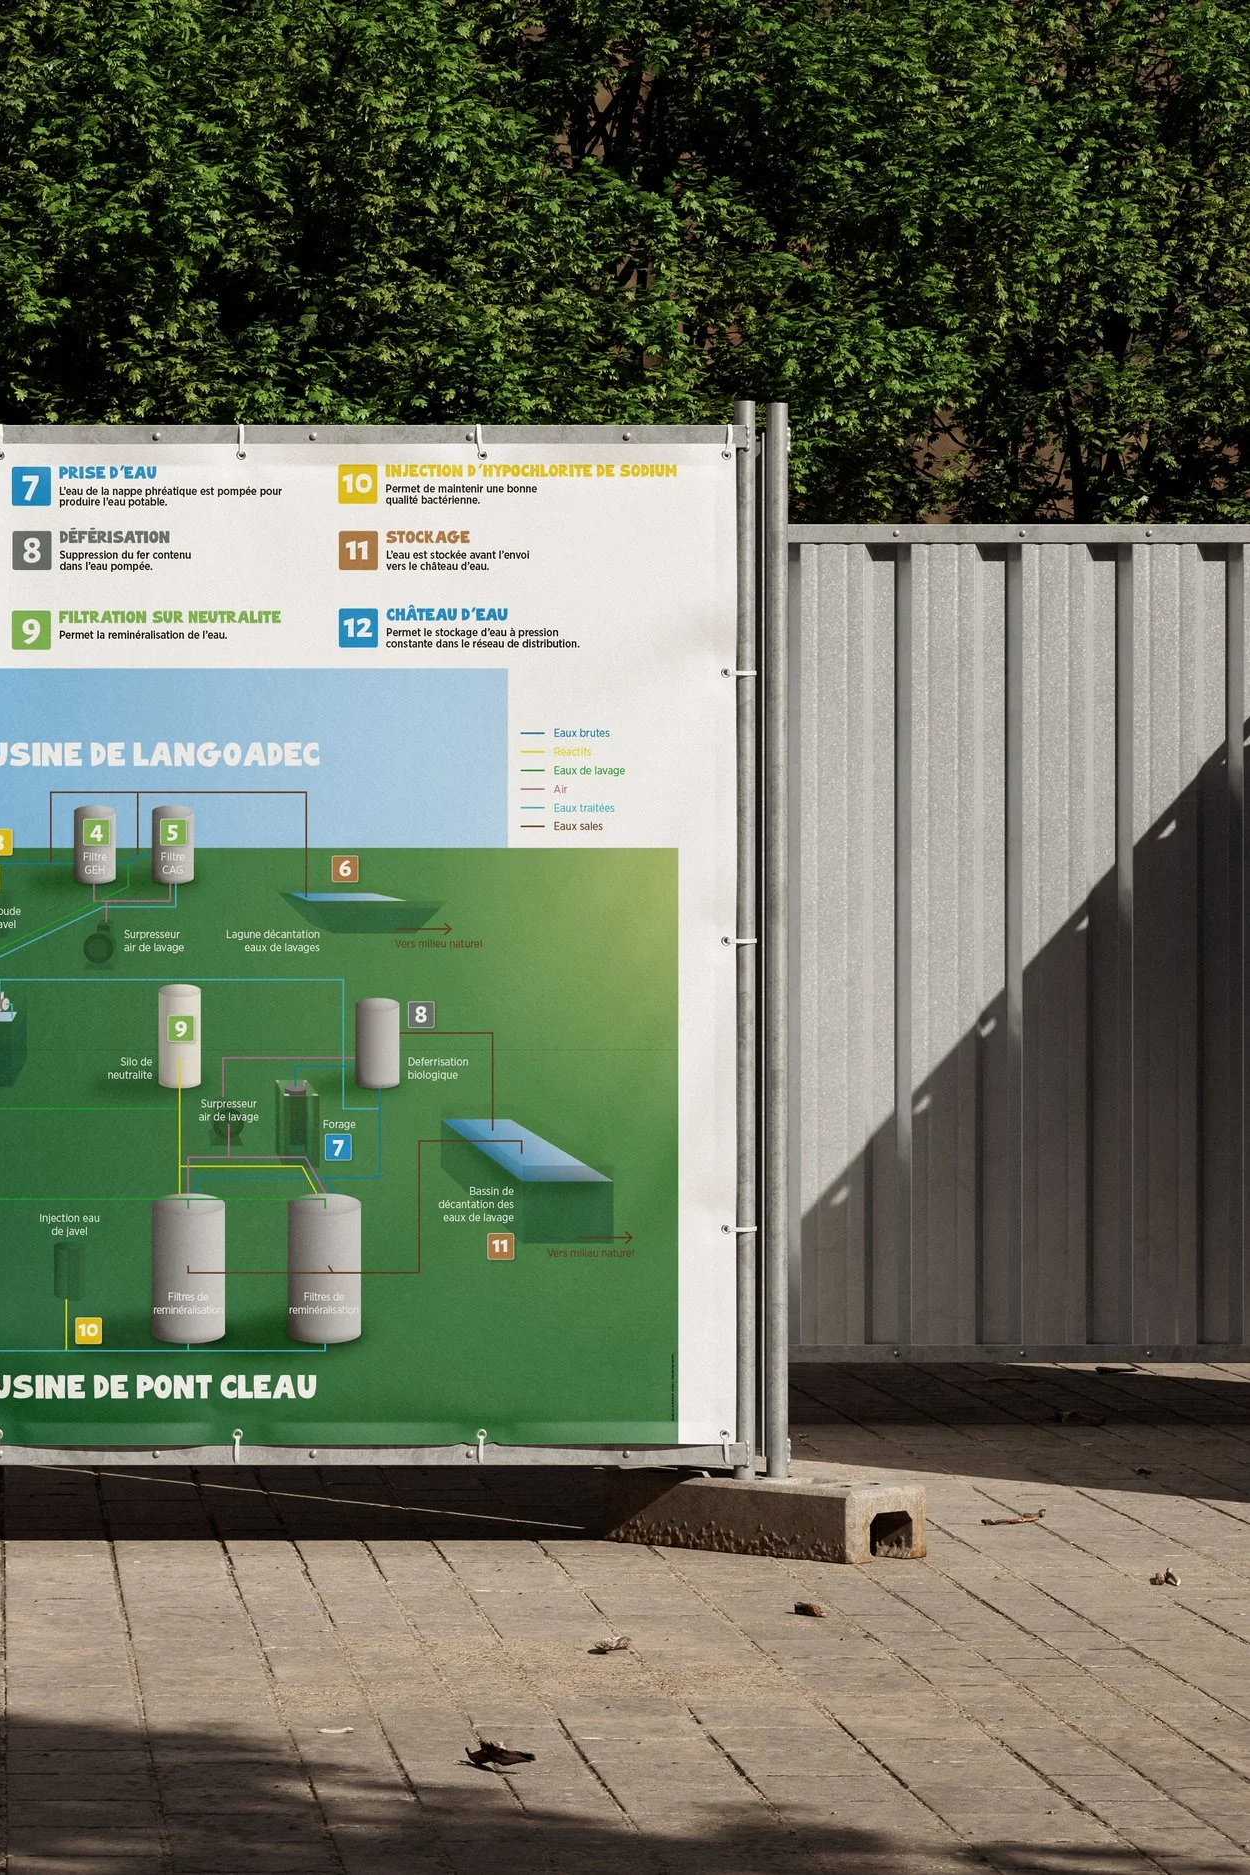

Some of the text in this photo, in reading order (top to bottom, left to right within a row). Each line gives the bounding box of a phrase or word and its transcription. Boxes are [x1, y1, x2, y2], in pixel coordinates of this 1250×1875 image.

[58, 464, 157, 480] PRISE D'EAU
[384, 462, 678, 479] INJECTION D'HYPOCHLORITE DE SODIUM
[21, 475, 40, 501] 7
[342, 474, 373, 493] 10
[59, 528, 171, 543] DÉFÉRISATION
[385, 529, 471, 545] STOCKAGE
[22, 538, 42, 563] 8
[59, 549, 192, 563] Suppression du fer contenu
[345, 541, 369, 560] 11
[59, 560, 153, 573] dans l'eau pompée.
[58, 610, 282, 624] FILTRATION SUR NEUTRALITE
[386, 605, 509, 622] CHÂTEAU D'EAU
[21, 619, 41, 644] 9
[59, 629, 228, 640] Permet la reminéralisation de l'eau.
[343, 618, 373, 637] 12
[553, 727, 611, 738] Eaux brutes
[90, 742, 126, 766] DE
[132, 742, 321, 767] LANGOADEC
[553, 746, 592, 757] Réactifs
[553, 765, 626, 777] Eaux de lavage
[553, 784, 569, 794] Air
[553, 802, 615, 813] Eaux traitées
[89, 825, 104, 841] 4
[166, 825, 179, 841] 5
[553, 821, 604, 831] Eaux sales
[338, 860, 352, 876] 6
[123, 929, 181, 941] Surpresseur
[123, 942, 185, 954] air de lavage
[414, 1006, 428, 1023] 8
[174, 1021, 188, 1037] 9
[120, 1056, 153, 1067] Silo de
[407, 1056, 469, 1067] Deferrisation
[407, 1069, 459, 1082] biologique
[322, 1119, 357, 1131] Forage
[332, 1140, 345, 1156] 7
[469, 1185, 515, 1196] Bassin de
[438, 1199, 515, 1209] décantation des
[443, 1212, 515, 1224] eaux de lavage
[491, 1238, 508, 1253] 11
[78, 1323, 99, 1337] 10
[93, 1375, 129, 1399] DE
[136, 1375, 213, 1399] PONT
[219, 1375, 317, 1399] CLEAU
